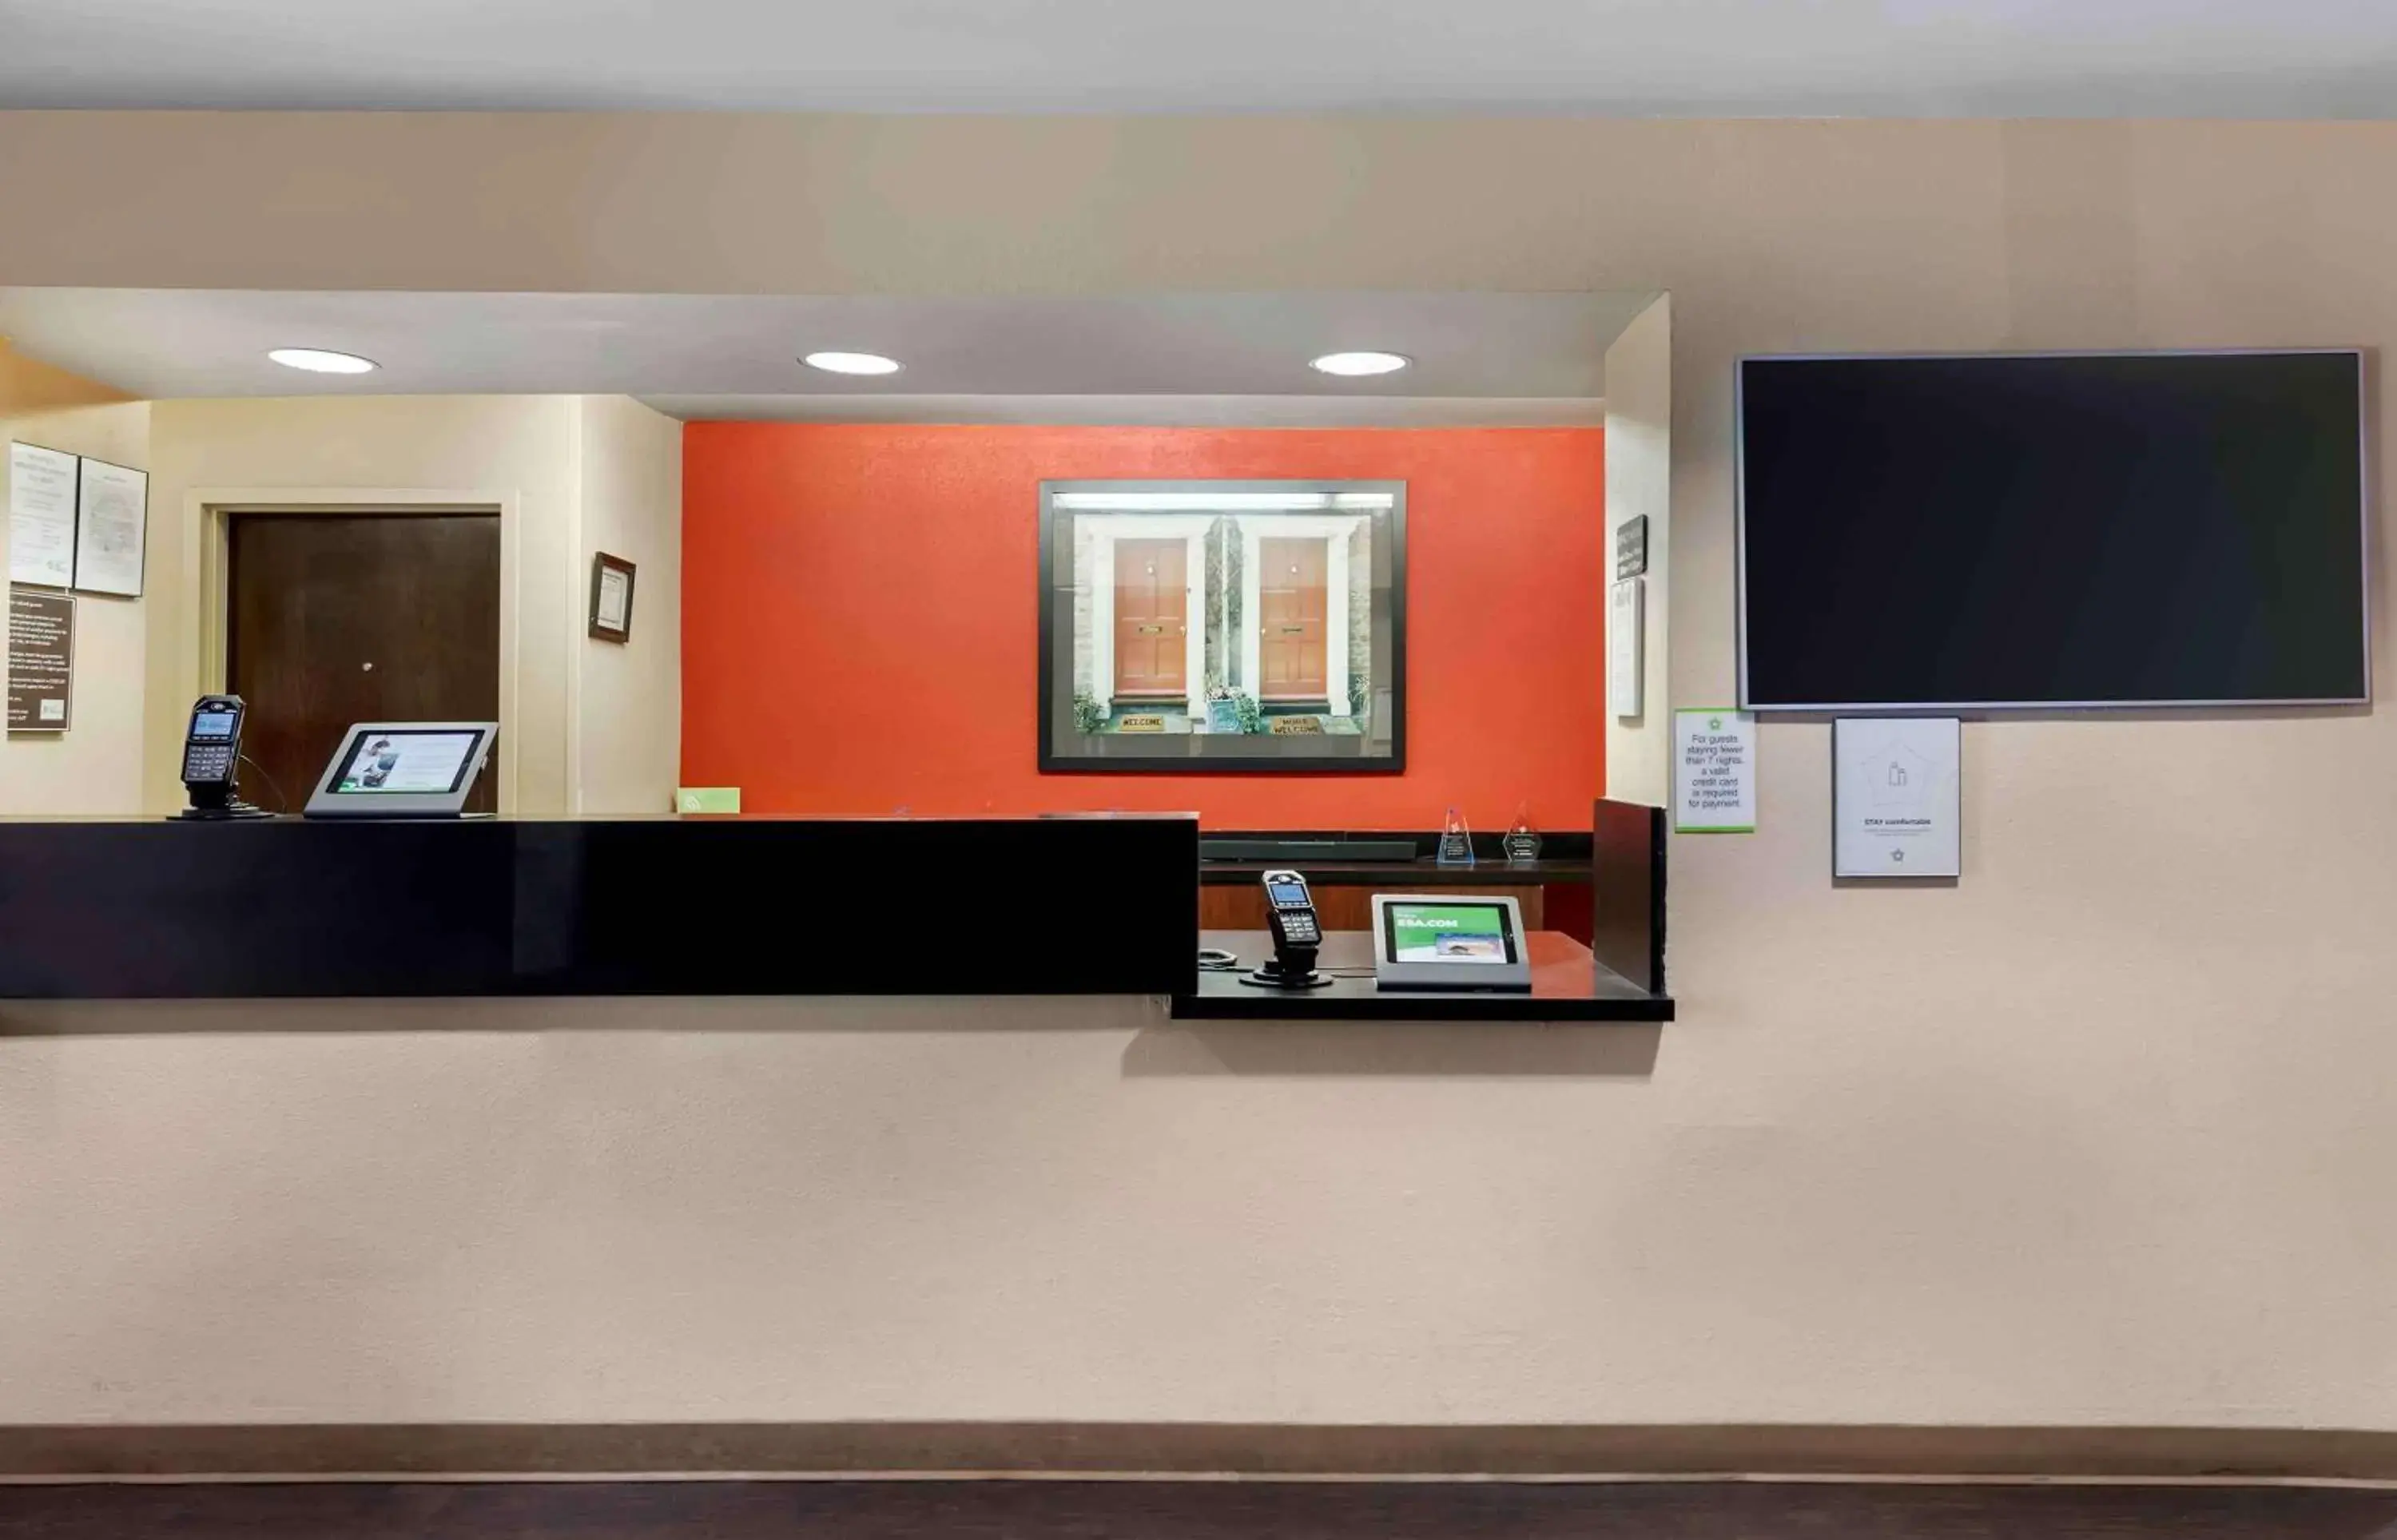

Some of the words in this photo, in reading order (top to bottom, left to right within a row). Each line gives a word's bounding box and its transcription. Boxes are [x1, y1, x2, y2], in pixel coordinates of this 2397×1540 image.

[1691, 734, 1706, 744] For
[1708, 735, 1739, 745] guests
[1687, 744, 1718, 756] staying
[1720, 744, 1744, 754] fewer
[1685, 756, 1706, 765] than
[1708, 756, 1714, 764] 7
[1709, 767, 1730, 776] valid
[1691, 777, 1717, 787] credit
[1719, 777, 1739, 787] card
[1703, 788, 1738, 799] required
[1688, 799, 1699, 808] for
[1397, 919, 1458, 927] ESA.COM
